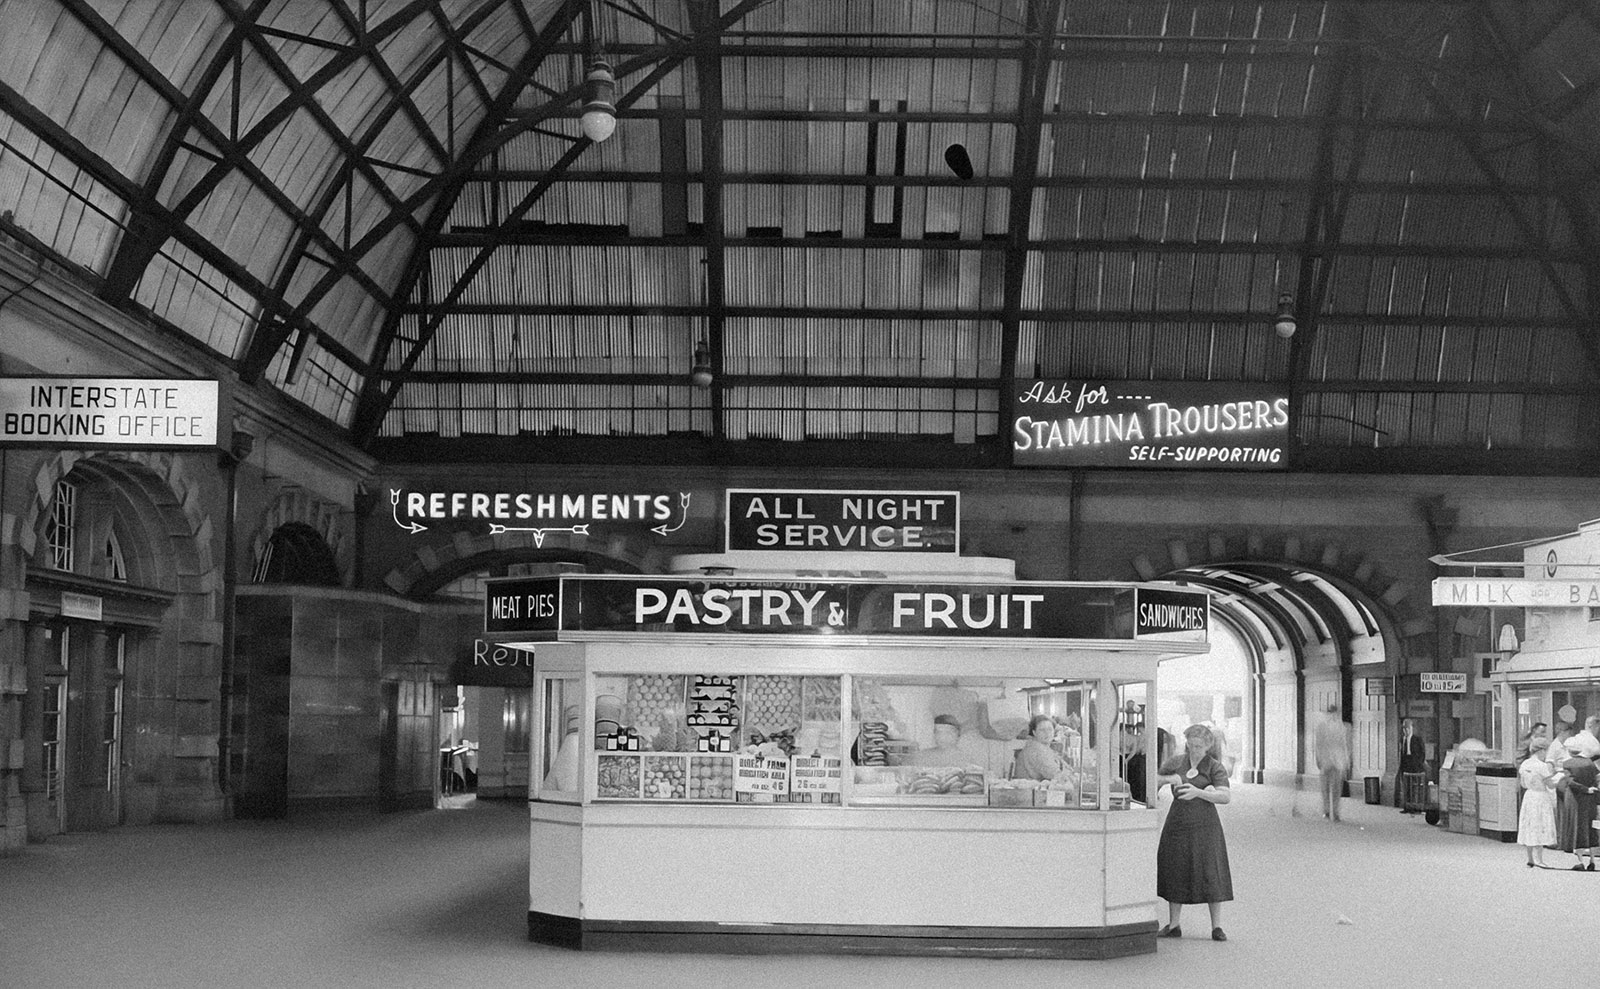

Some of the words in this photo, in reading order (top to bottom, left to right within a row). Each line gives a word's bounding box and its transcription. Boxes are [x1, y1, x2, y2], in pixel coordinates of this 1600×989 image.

[30, 385, 179, 409] INTERSTATE
[1019, 381, 1072, 404] Ask
[1075, 383, 1110, 413] for
[4, 413, 106, 436] BOOKING
[117, 415, 203, 437] OFFICE
[1013, 412, 1144, 451] STAMINA
[1147, 397, 1289, 438] TROUSERS
[1129, 445, 1282, 463] SELF-SUPPORTING
[406, 492, 672, 521] REFRESHMENTS
[745, 497, 816, 519] ALL
[842, 498, 945, 521] NIGHT
[756, 524, 932, 548] SERVICE.
[492, 595, 521, 619] MEAT
[527, 593, 555, 618] PIES
[1451, 583, 1514, 604] MILK
[635, 587, 827, 627] PASTRY
[827, 601, 845, 627] &
[892, 591, 1044, 630] FRUIT
[1139, 602, 1205, 630] SANDWICHES
